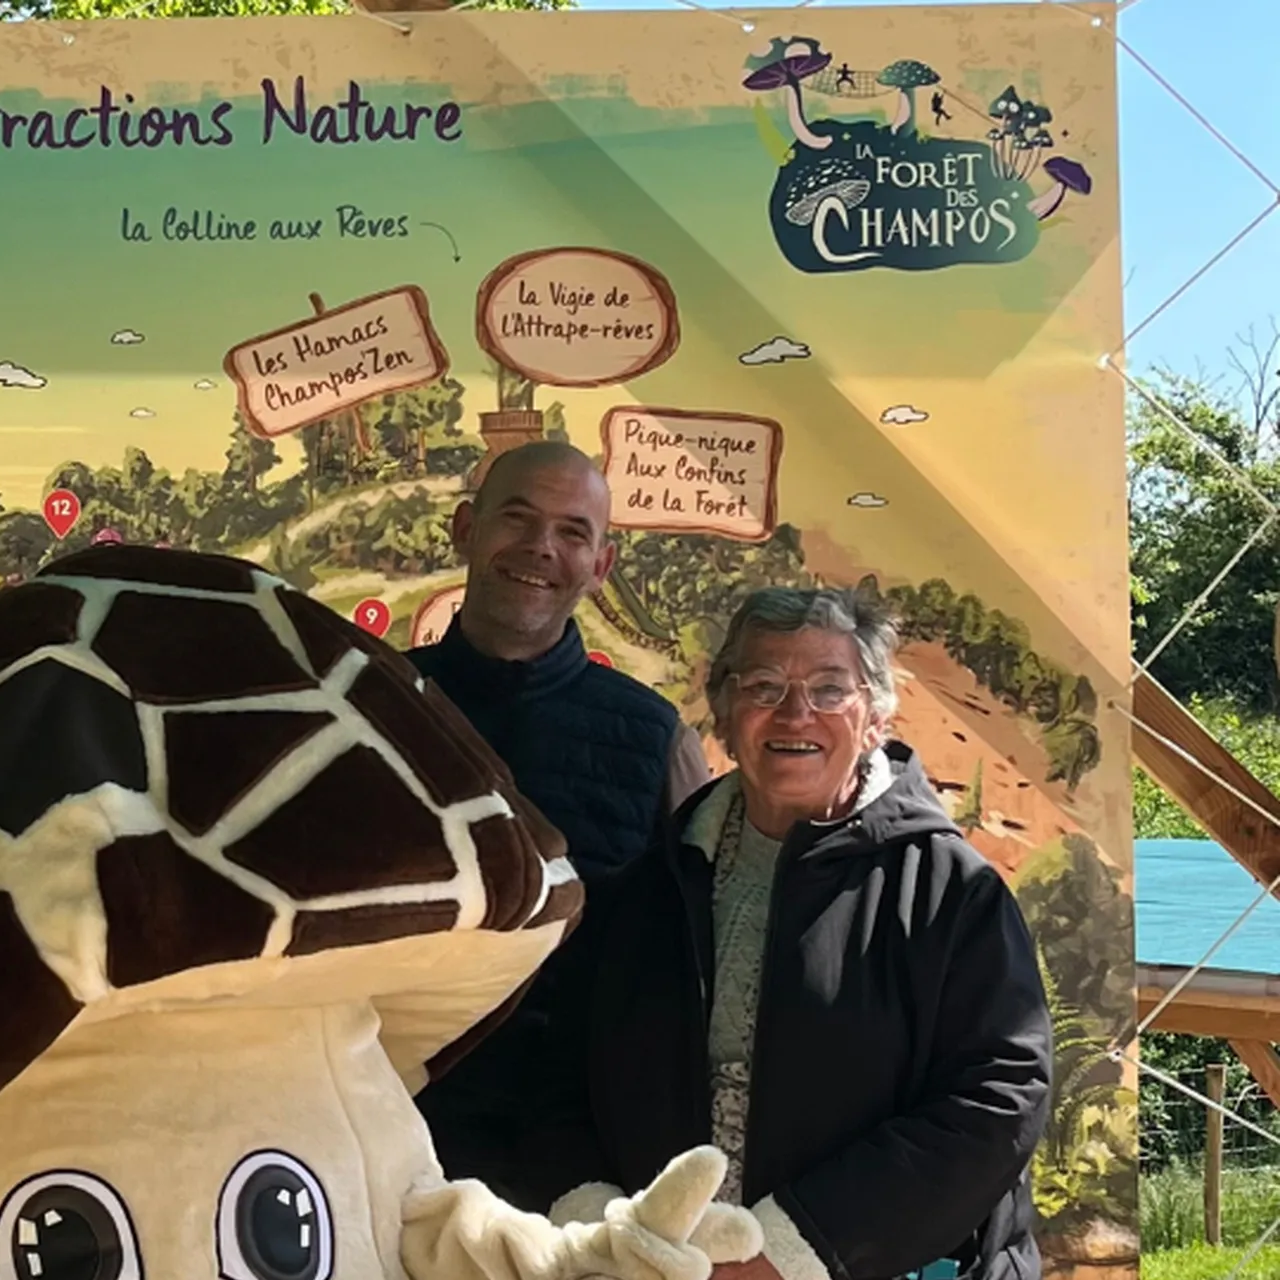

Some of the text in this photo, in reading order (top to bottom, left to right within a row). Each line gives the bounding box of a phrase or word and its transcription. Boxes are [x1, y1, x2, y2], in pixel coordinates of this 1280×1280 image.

[261, 75, 463, 145] Nature
[856, 143, 875, 160] LA
[875, 153, 983, 189] FORÊT
[163, 207, 257, 242] Colline
[270, 215, 323, 241] aux
[336, 205, 410, 239] Rêves
[812, 196, 1019, 263] CHAMPOS
[549, 281, 596, 315] Vigie
[604, 286, 631, 308] de
[293, 315, 389, 363] Hamacs
[624, 418, 757, 458] Pique-nique
[626, 451, 748, 485] Aux Confins
[50, 499, 72, 516] 12
[627, 488, 654, 510] de
[662, 488, 686, 513] la
[365, 607, 378, 624] 9
